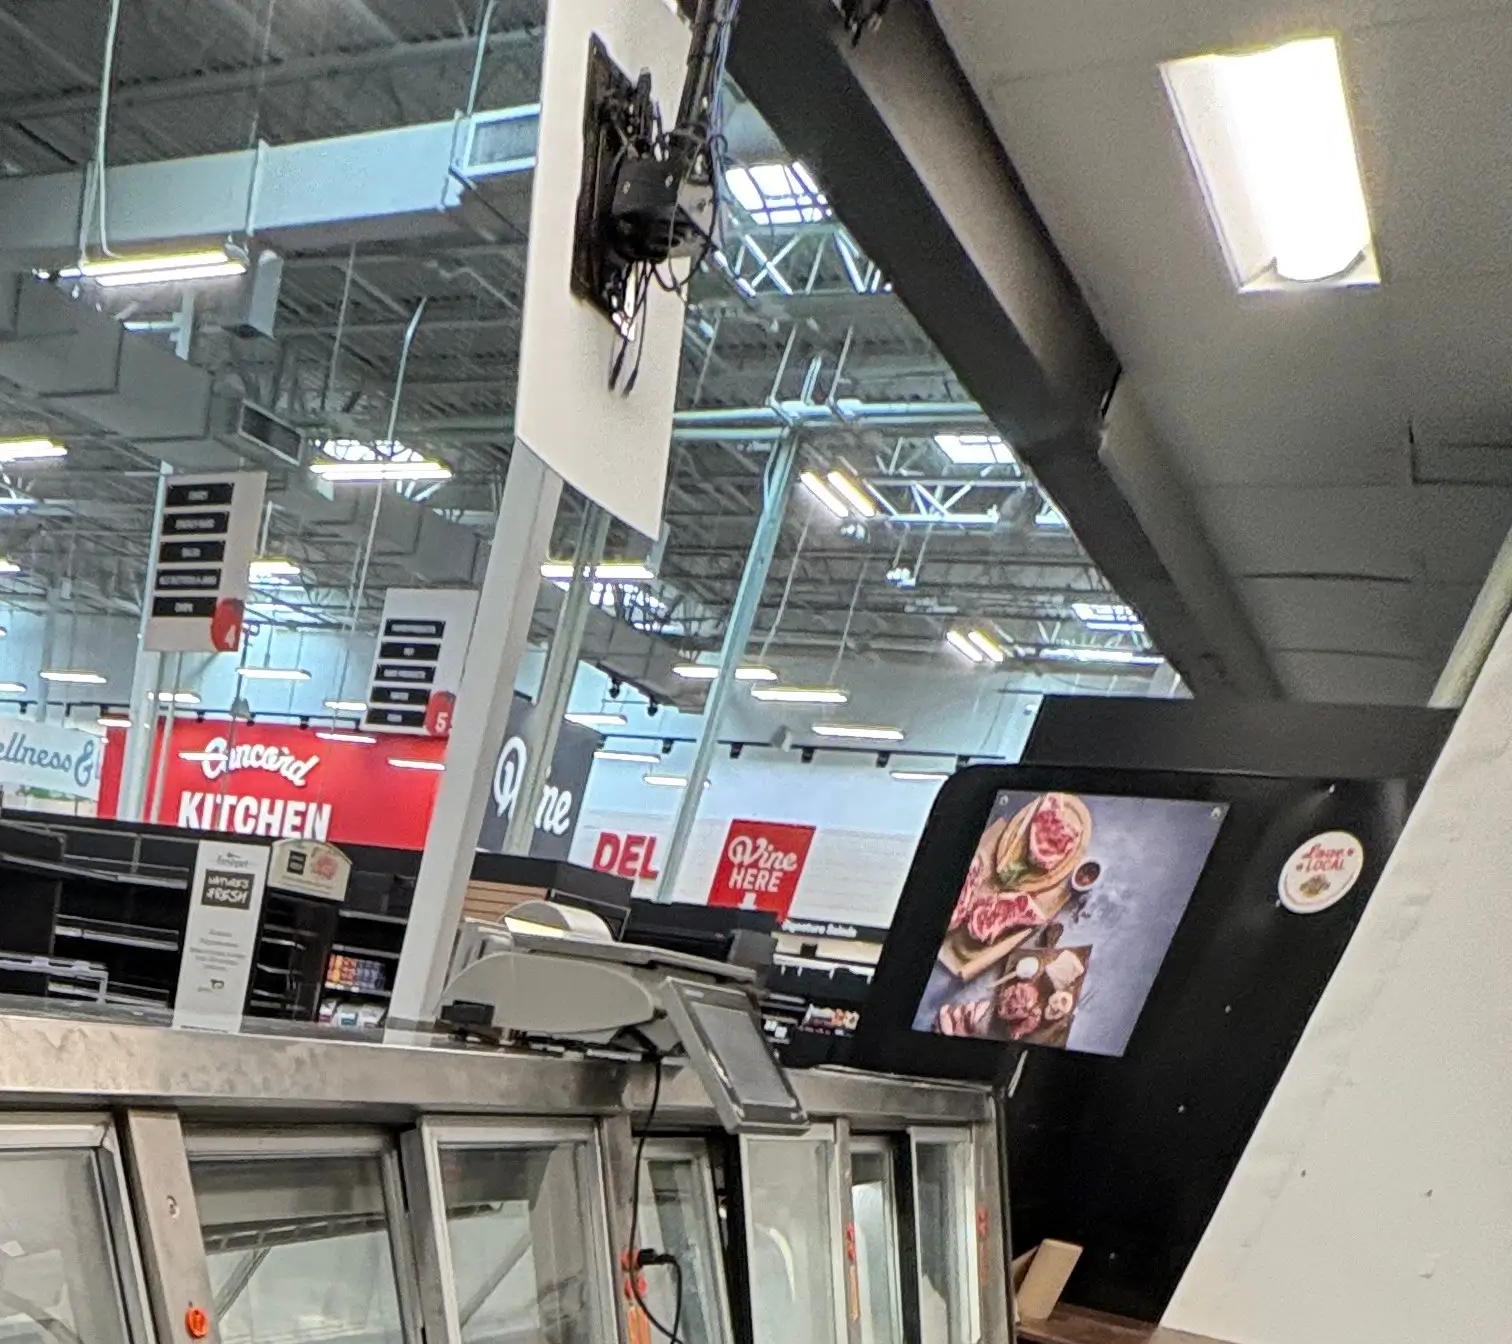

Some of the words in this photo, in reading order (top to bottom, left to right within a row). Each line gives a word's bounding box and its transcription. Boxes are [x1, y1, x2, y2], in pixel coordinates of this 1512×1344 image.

[224, 624, 237, 648] 4
[435, 711, 449, 734] 5
[177, 790, 332, 842] KITCHEN
[1304, 859, 1345, 872] LOCAL
[728, 867, 784, 892] HERE
